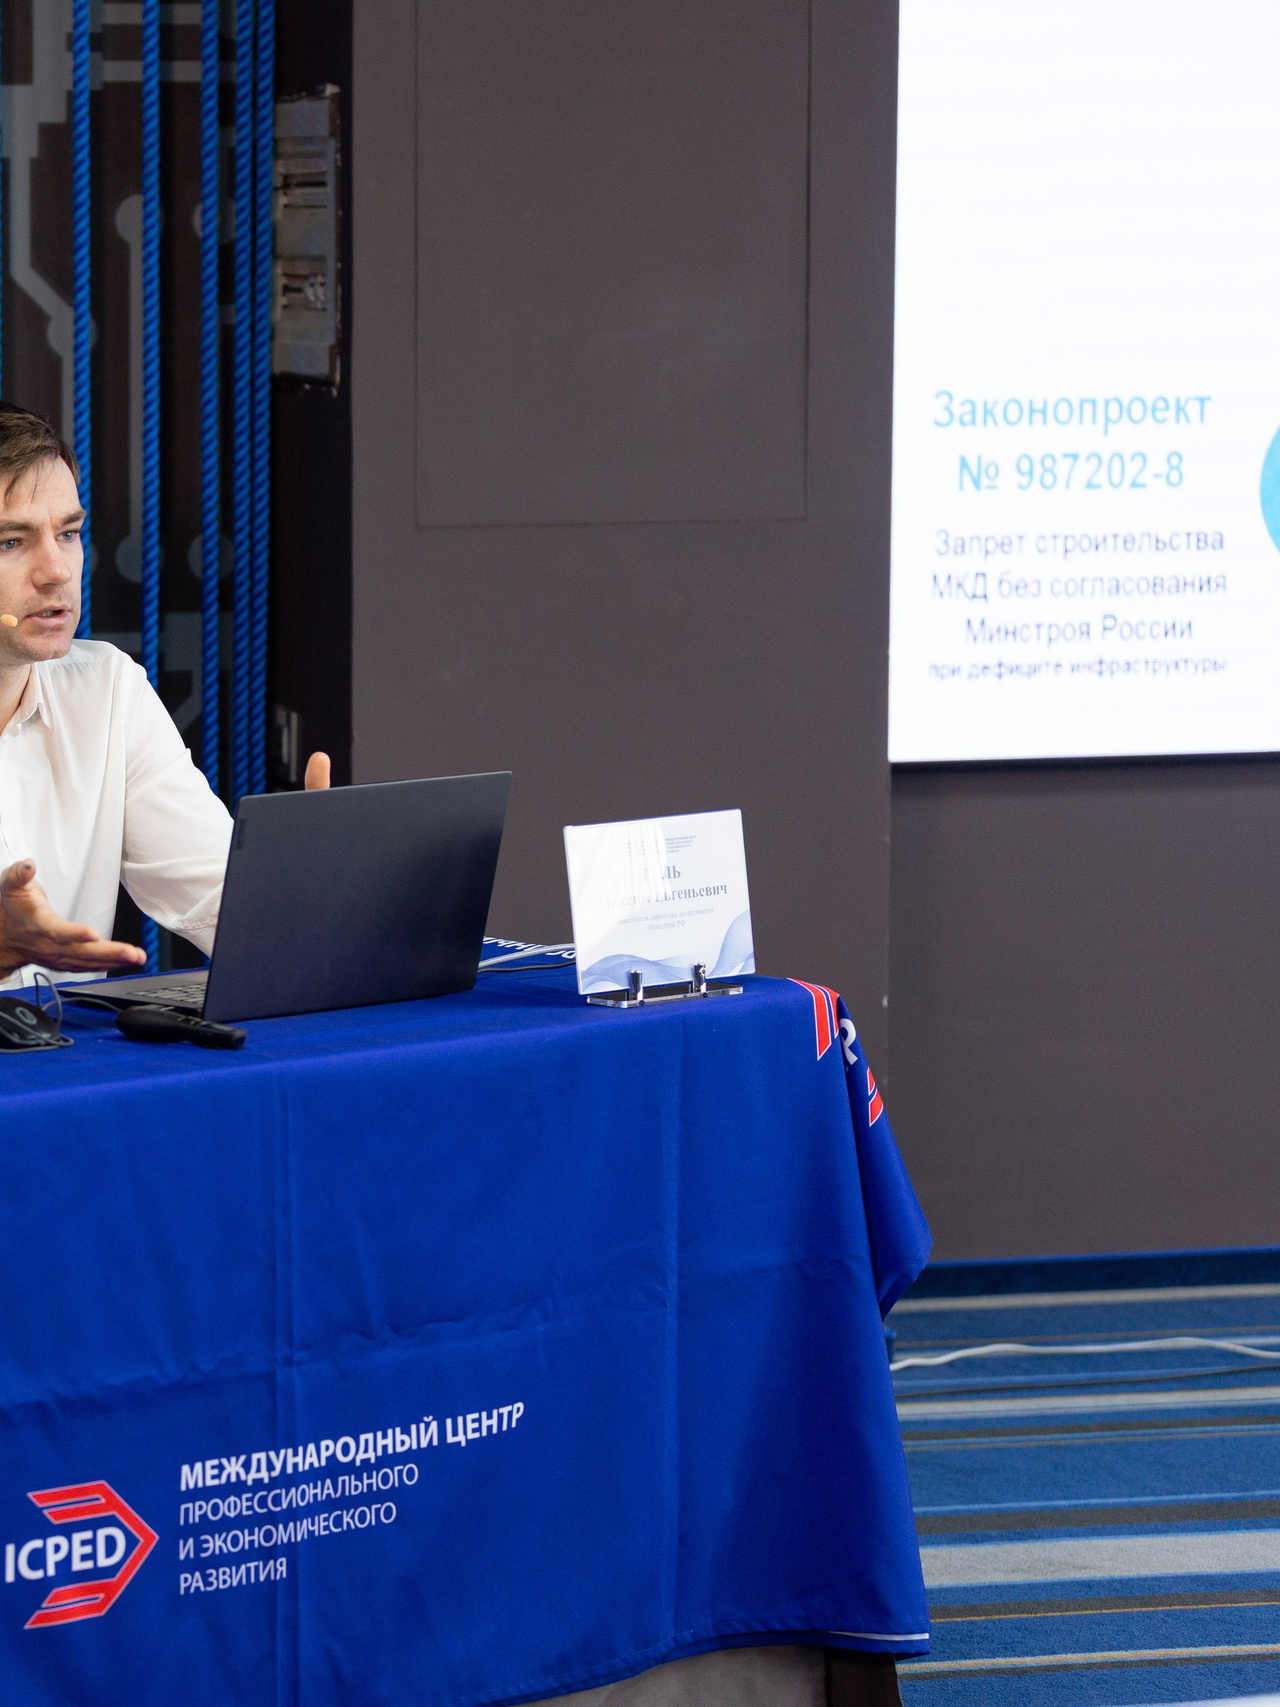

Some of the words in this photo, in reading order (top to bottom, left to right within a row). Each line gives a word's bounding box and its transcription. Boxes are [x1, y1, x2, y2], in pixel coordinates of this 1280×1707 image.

[933, 389, 1212, 436] Законопроект
[958, 453, 1001, 492] №
[1016, 450, 1184, 491] 987202-8
[934, 528, 1026, 561] Запрет
[1035, 530, 1225, 560] строительства
[932, 571, 989, 603] МКД
[998, 570, 1042, 598] без
[1050, 574, 1227, 598] согласования
[966, 616, 1091, 648] Минстроя
[1101, 613, 1193, 642] России
[1070, 655, 1226, 678] инфраструктуры
[179, 1416, 439, 1492] МЕЖДУНАРОДНЫЙ
[445, 1401, 525, 1447] ЦЕНТР
[179, 1463, 419, 1526] ПРОФЕССИОНАЛЬНОГО
[179, 1538, 195, 1561] И
[199, 1501, 398, 1559] ЭКОНОМИЧЕСКОГО
[5, 1526, 127, 1583] ICPED
[179, 1557, 288, 1596] РАЗВИТИЯ
